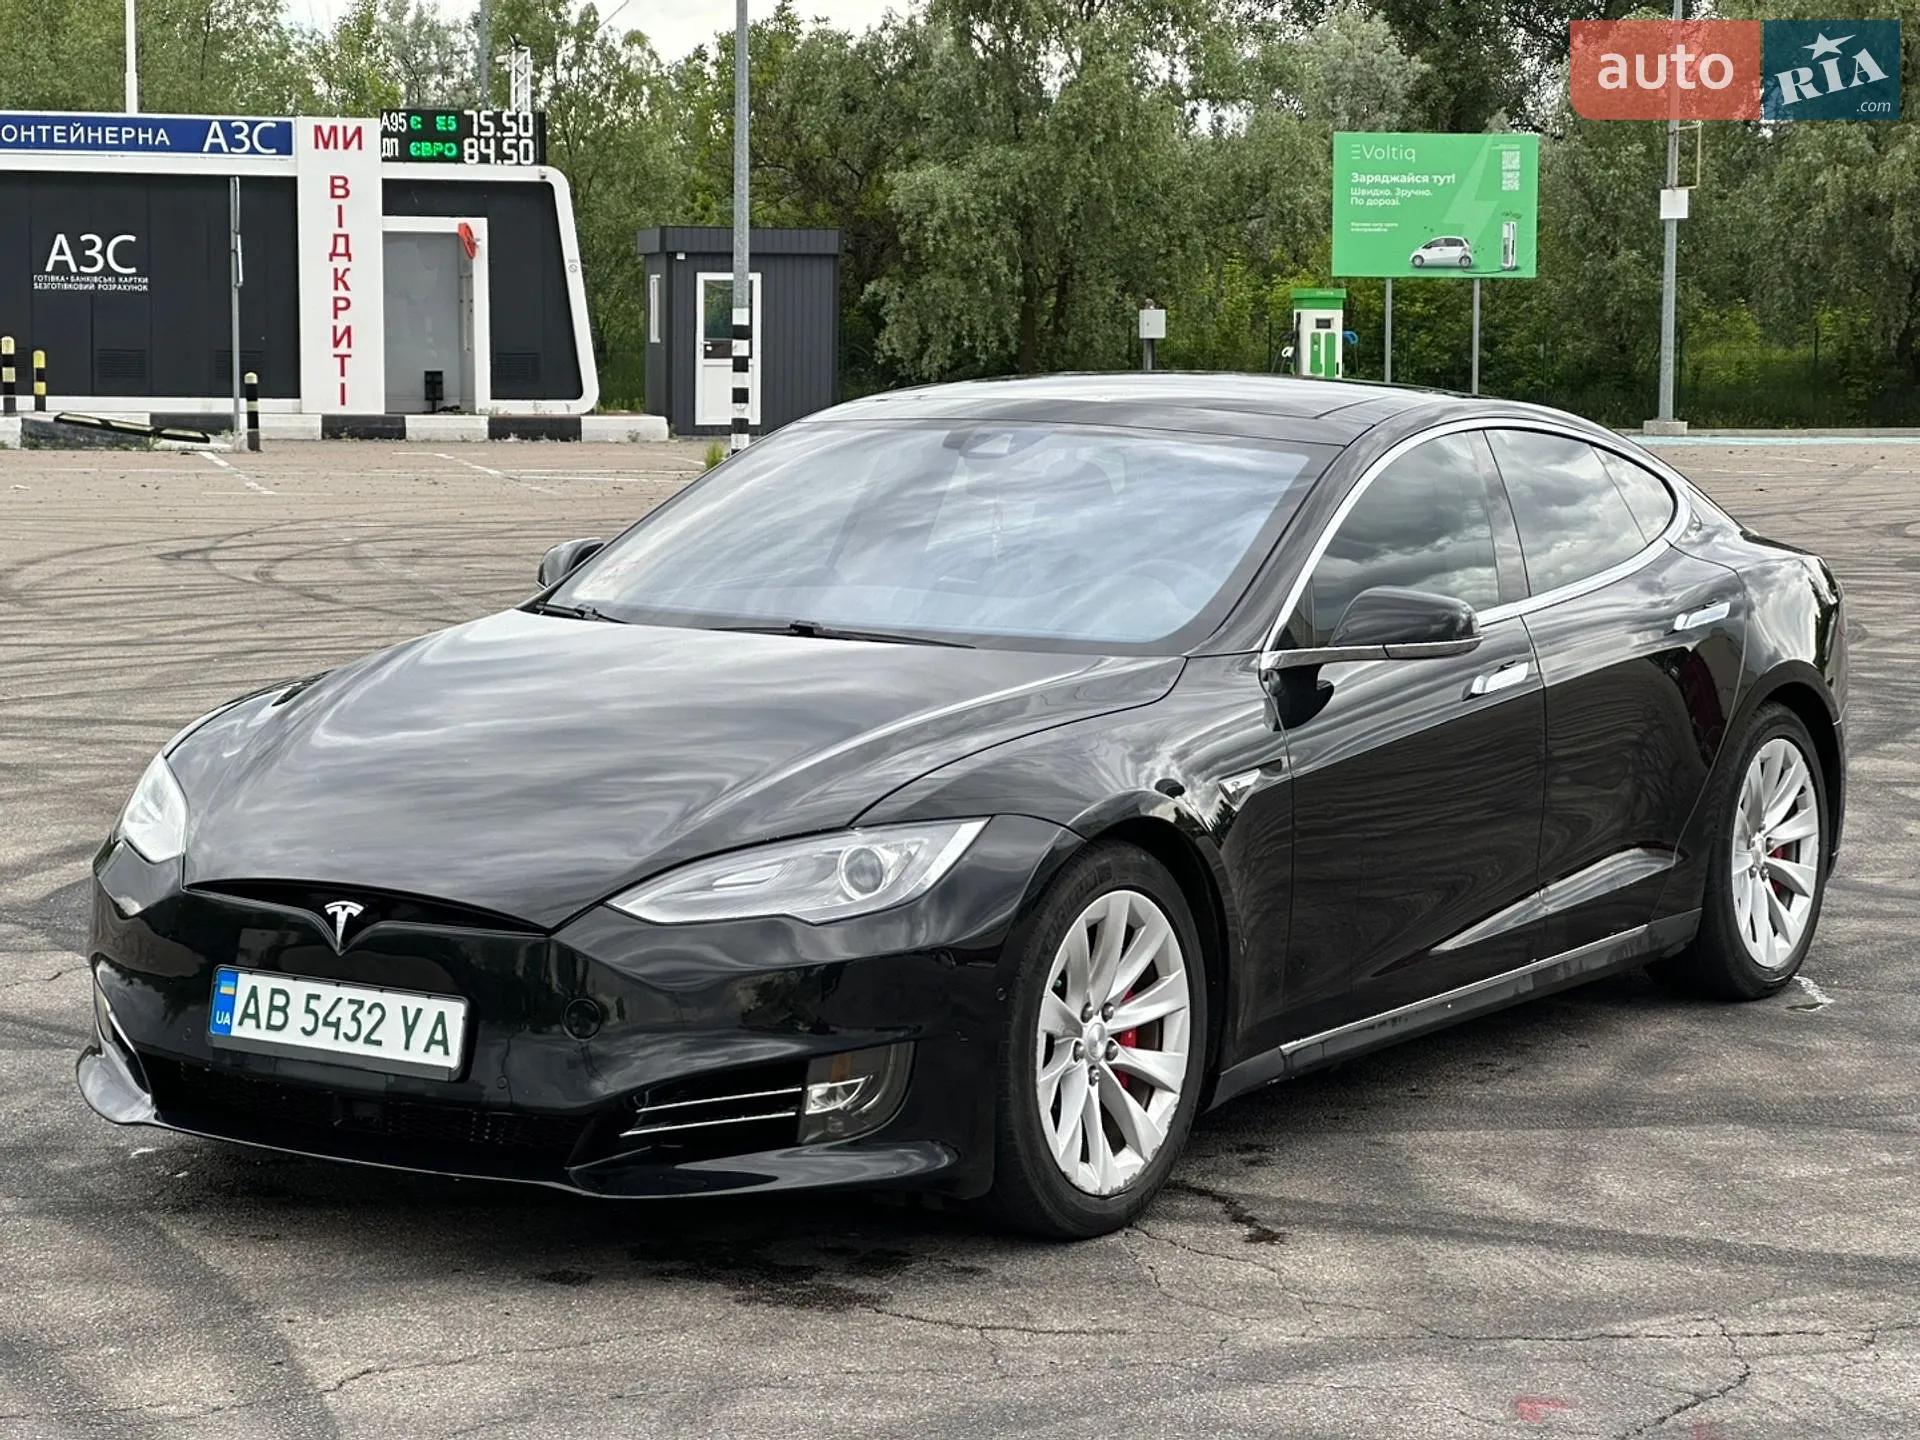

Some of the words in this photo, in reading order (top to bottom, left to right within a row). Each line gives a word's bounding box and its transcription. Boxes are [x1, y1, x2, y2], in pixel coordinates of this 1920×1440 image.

[0, 122, 171, 147] ОНТЕЙНЕРНА
[202, 120, 277, 154] АЗС
[312, 124, 364, 151] МИ
[463, 109, 534, 138] 75.50
[381, 137, 399, 158] ДП
[463, 137, 534, 165] 84.50
[1351, 172, 1429, 185] Заряджайся
[1431, 173, 1456, 186] тут!
[1350, 197, 1365, 206] По
[45, 233, 137, 275] АЗС
[328, 175, 353, 406] ВІДКРИТІ
[215, 1010, 231, 1026] UA
[237, 985, 291, 1032] AB
[300, 993, 386, 1047] 5432
[401, 1005, 451, 1057] YA
